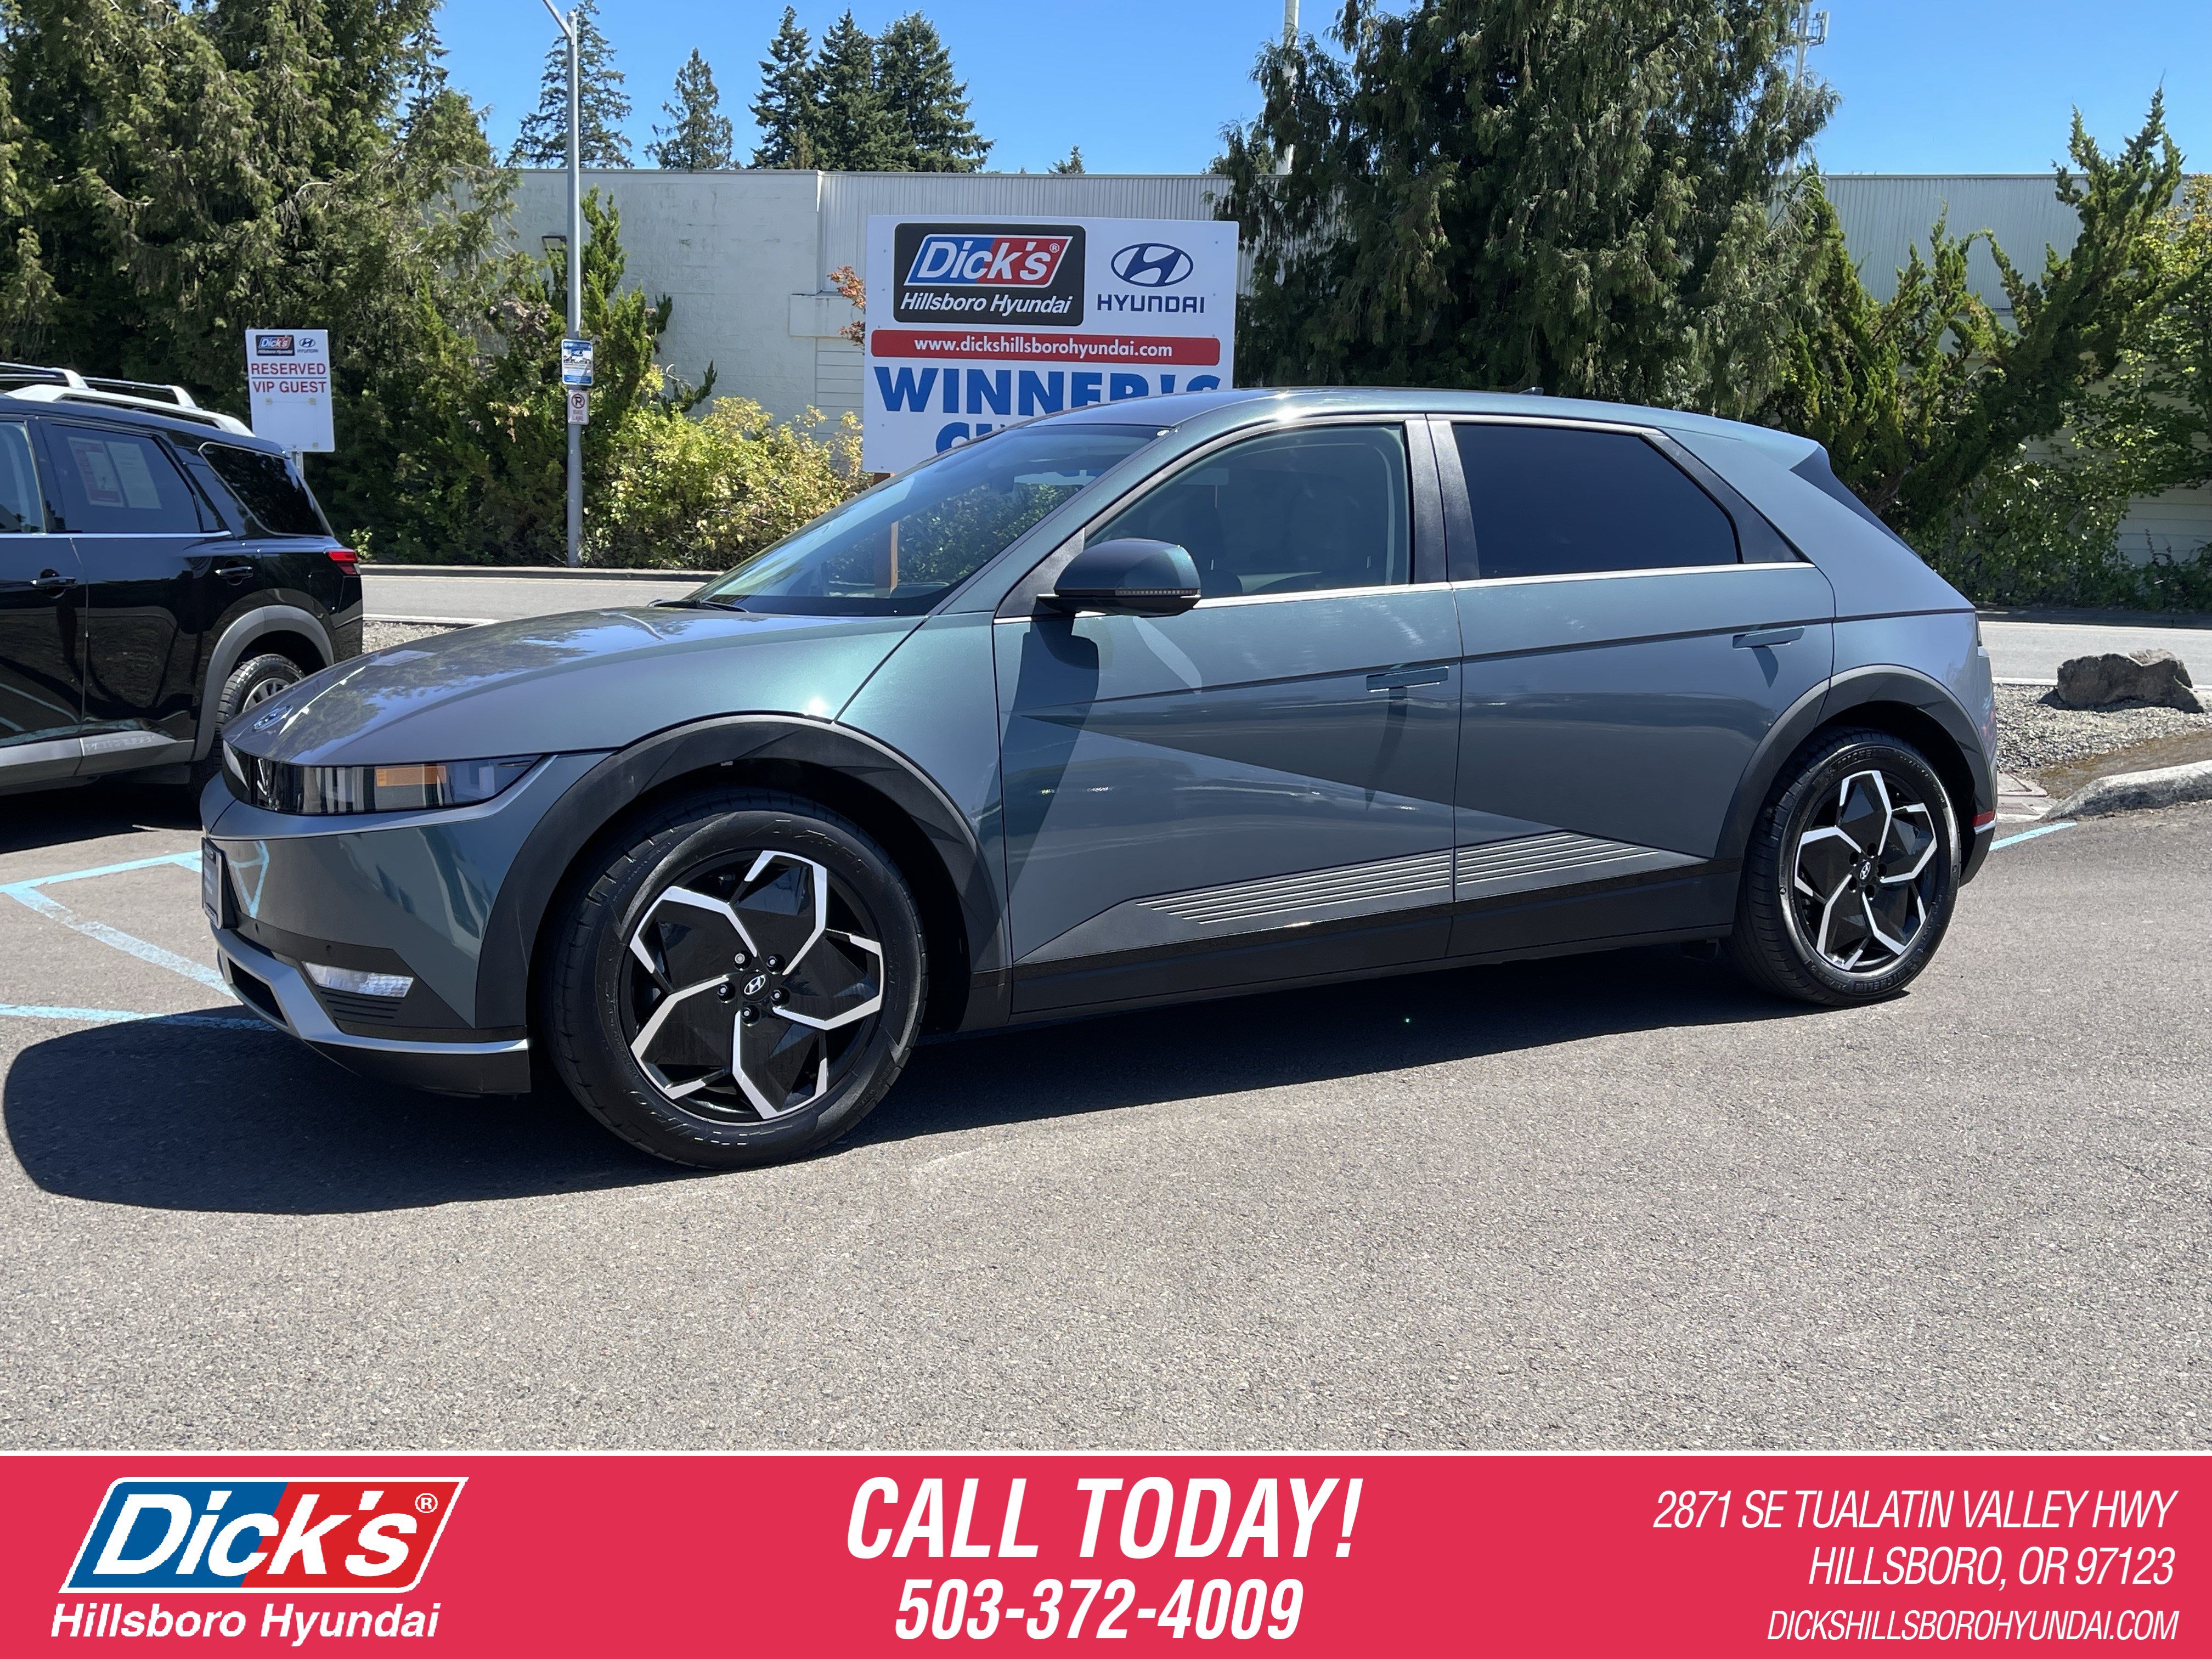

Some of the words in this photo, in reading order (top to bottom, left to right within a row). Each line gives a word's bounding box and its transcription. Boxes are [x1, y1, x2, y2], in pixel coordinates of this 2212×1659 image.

[900, 292, 987, 311] Hillsboro
[990, 294, 1073, 317] Hyundai
[1097, 294, 1204, 313] HYUNDAI
[914, 335, 1172, 359] www.dickshillsborohyundai.com
[251, 363, 326, 375] RESERVED
[252, 381, 275, 393] VIP
[279, 381, 326, 393] GUEST
